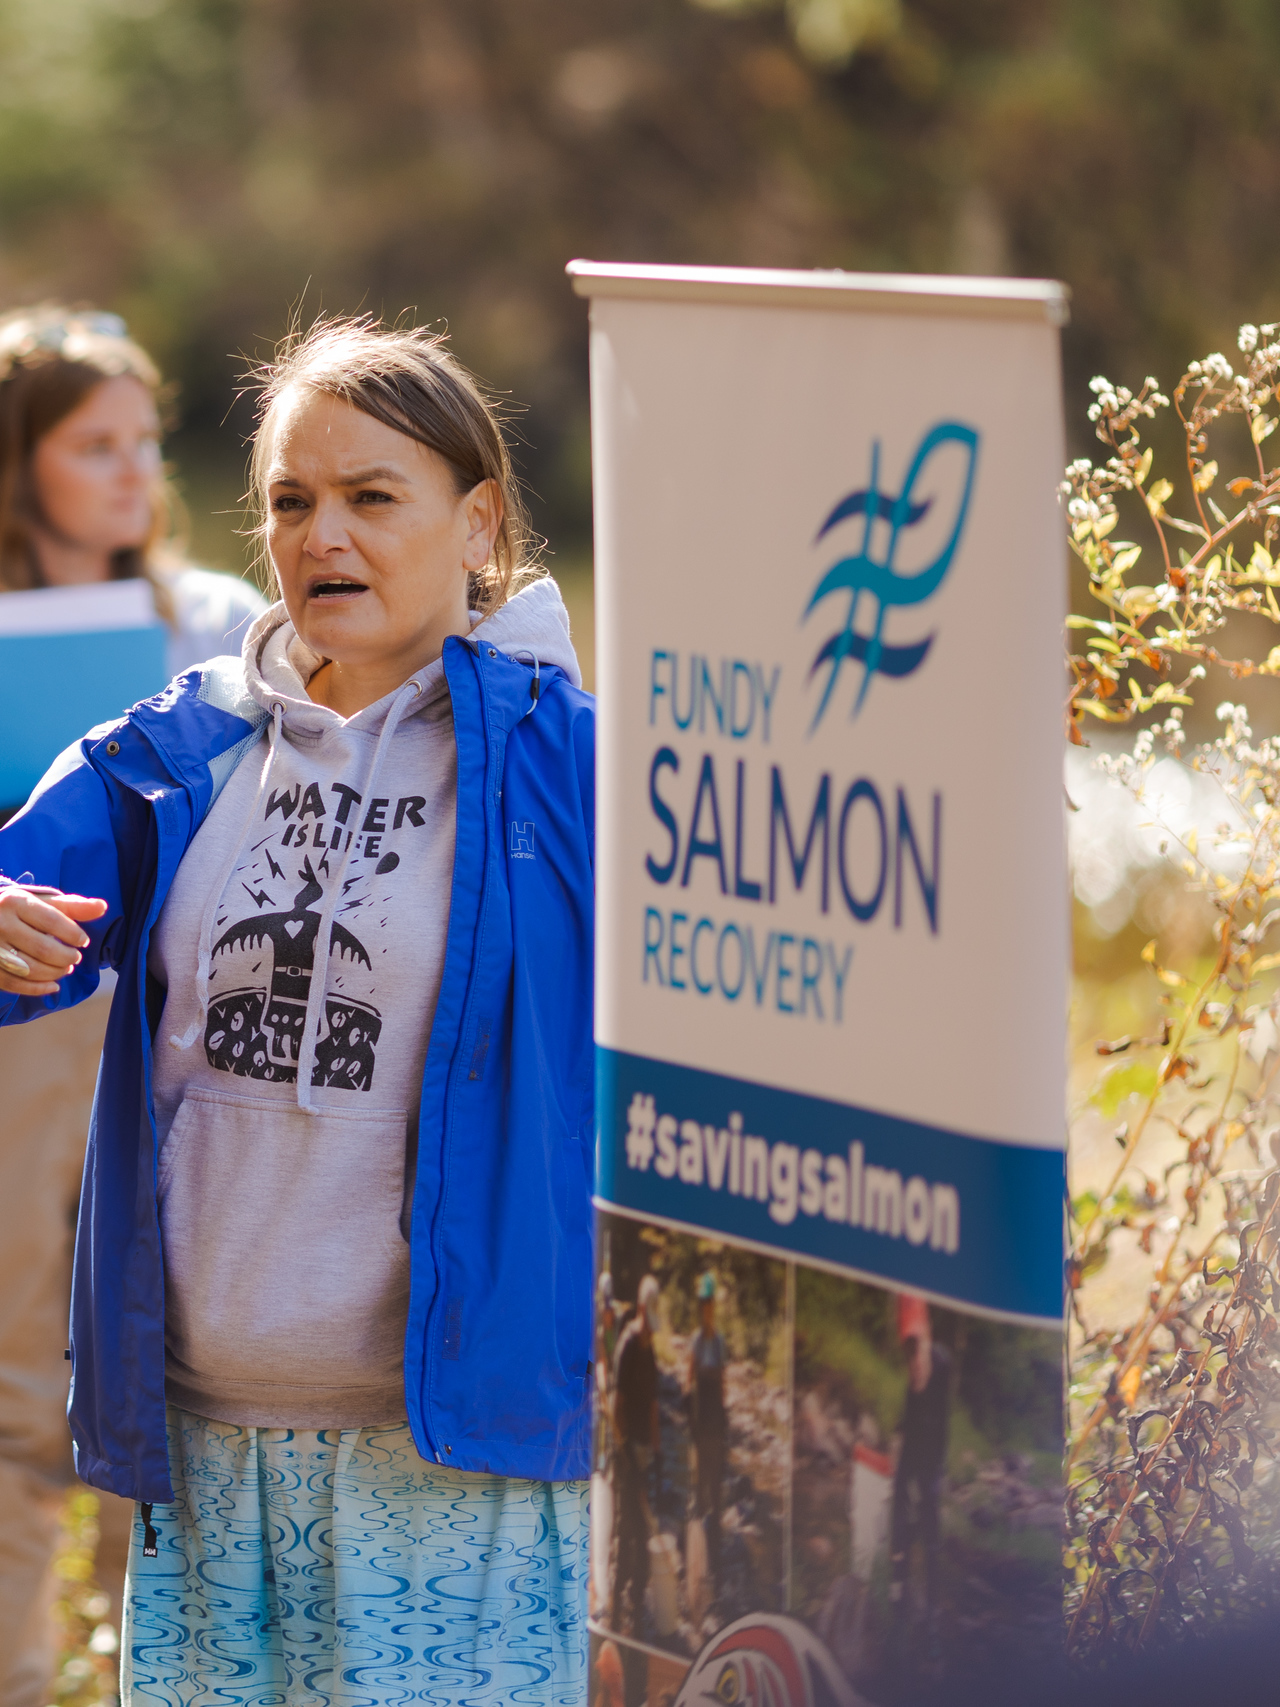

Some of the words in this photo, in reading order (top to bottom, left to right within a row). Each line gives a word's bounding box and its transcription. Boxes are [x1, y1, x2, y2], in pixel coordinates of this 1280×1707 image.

[649, 648, 781, 744] FUNDY
[264, 781, 427, 832] WATER
[281, 823, 309, 848] IS
[312, 822, 383, 859] LIFE
[644, 745, 943, 938] SALMON
[641, 905, 854, 1025] RECOVERY
[625, 1092, 961, 1255] #savingsalmon
